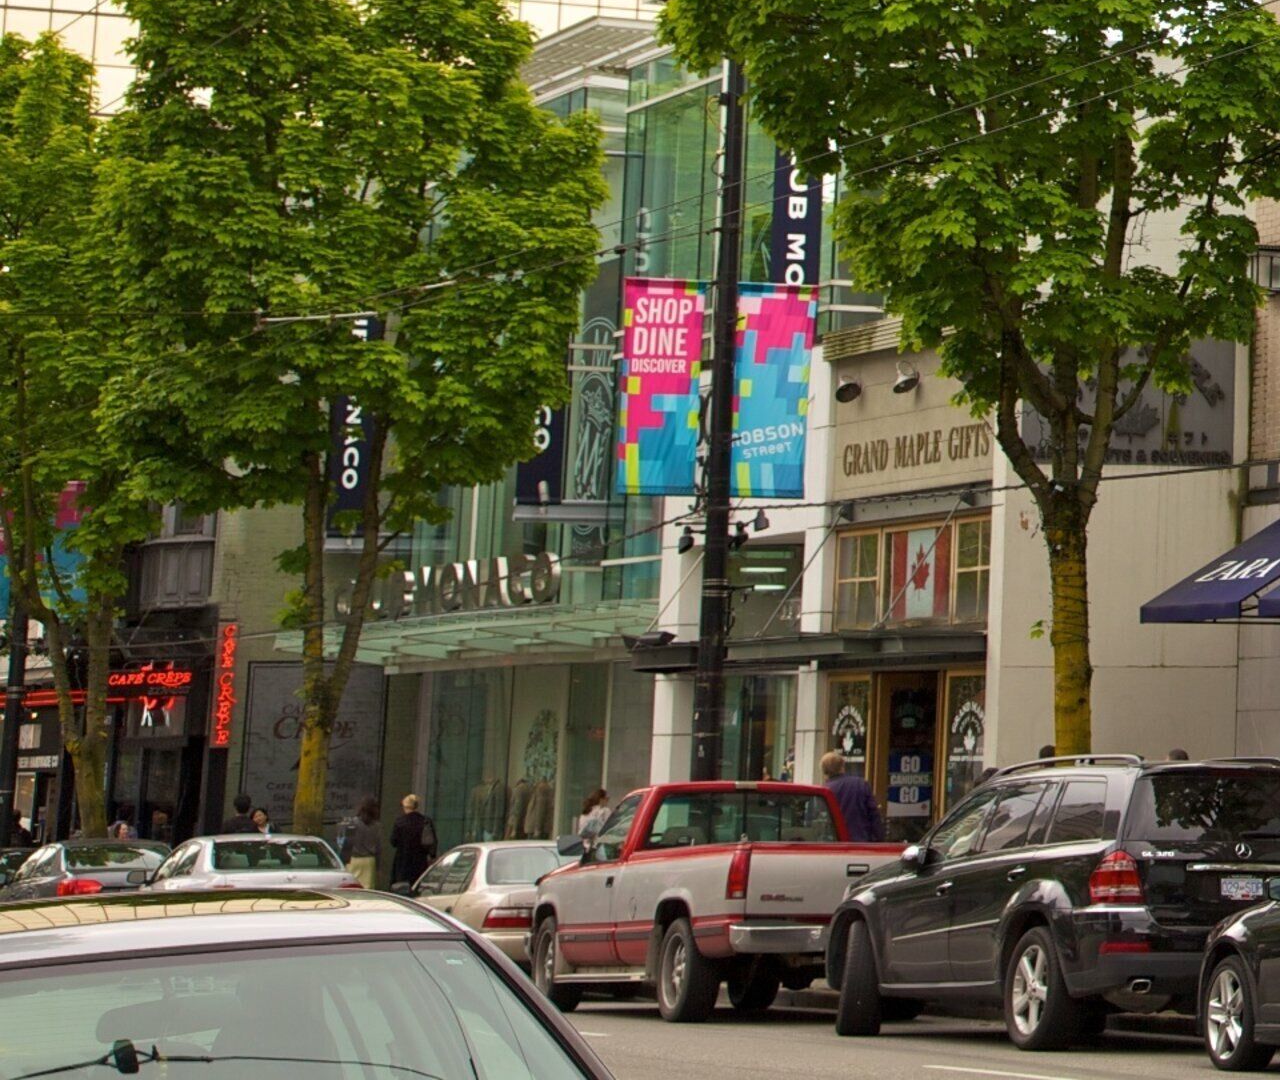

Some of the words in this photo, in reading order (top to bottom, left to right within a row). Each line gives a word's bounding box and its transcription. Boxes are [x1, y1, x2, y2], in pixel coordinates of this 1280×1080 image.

[635, 297, 693, 324] SHOP
[633, 327, 688, 356] DINE
[631, 358, 686, 373] DISCOVER
[843, 439, 889, 477] GRAND
[894, 430, 942, 469] MAPLE
[948, 422, 990, 461] GIFTS
[901, 756, 921, 773] GO
[890, 774, 930, 784] CANUCKS
[900, 787, 919, 802] GO
